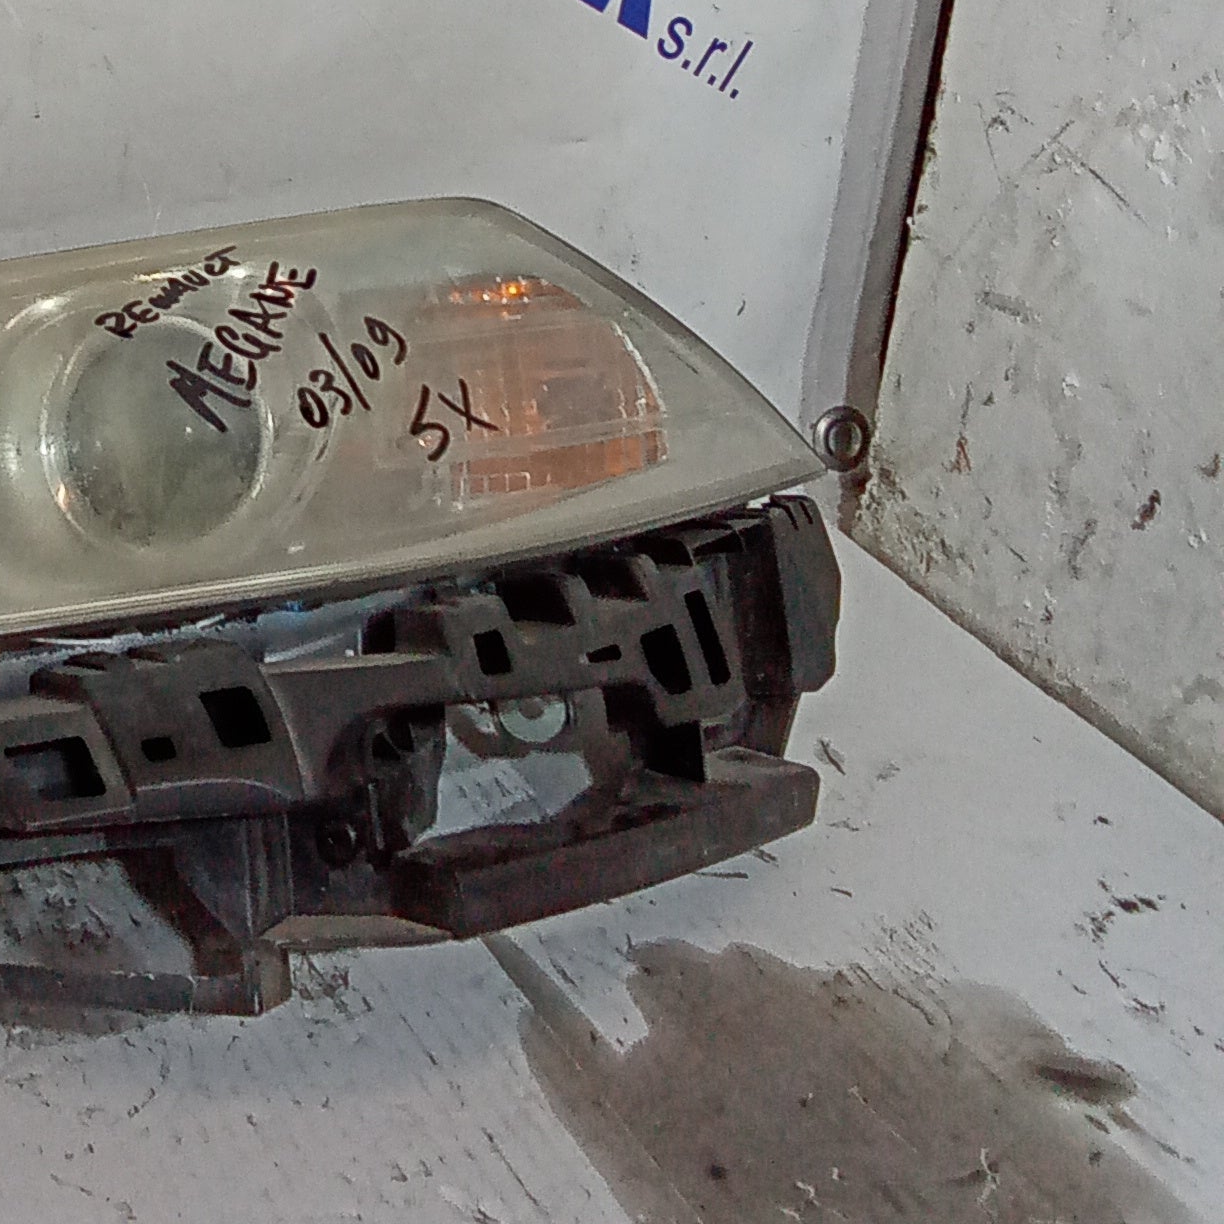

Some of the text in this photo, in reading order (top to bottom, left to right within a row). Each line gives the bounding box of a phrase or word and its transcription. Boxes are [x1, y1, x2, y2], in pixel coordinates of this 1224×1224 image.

[656, 16, 755, 100] s.r.l.
[166, 261, 317, 433] MEGANE
[298, 316, 409, 429] 03/09
